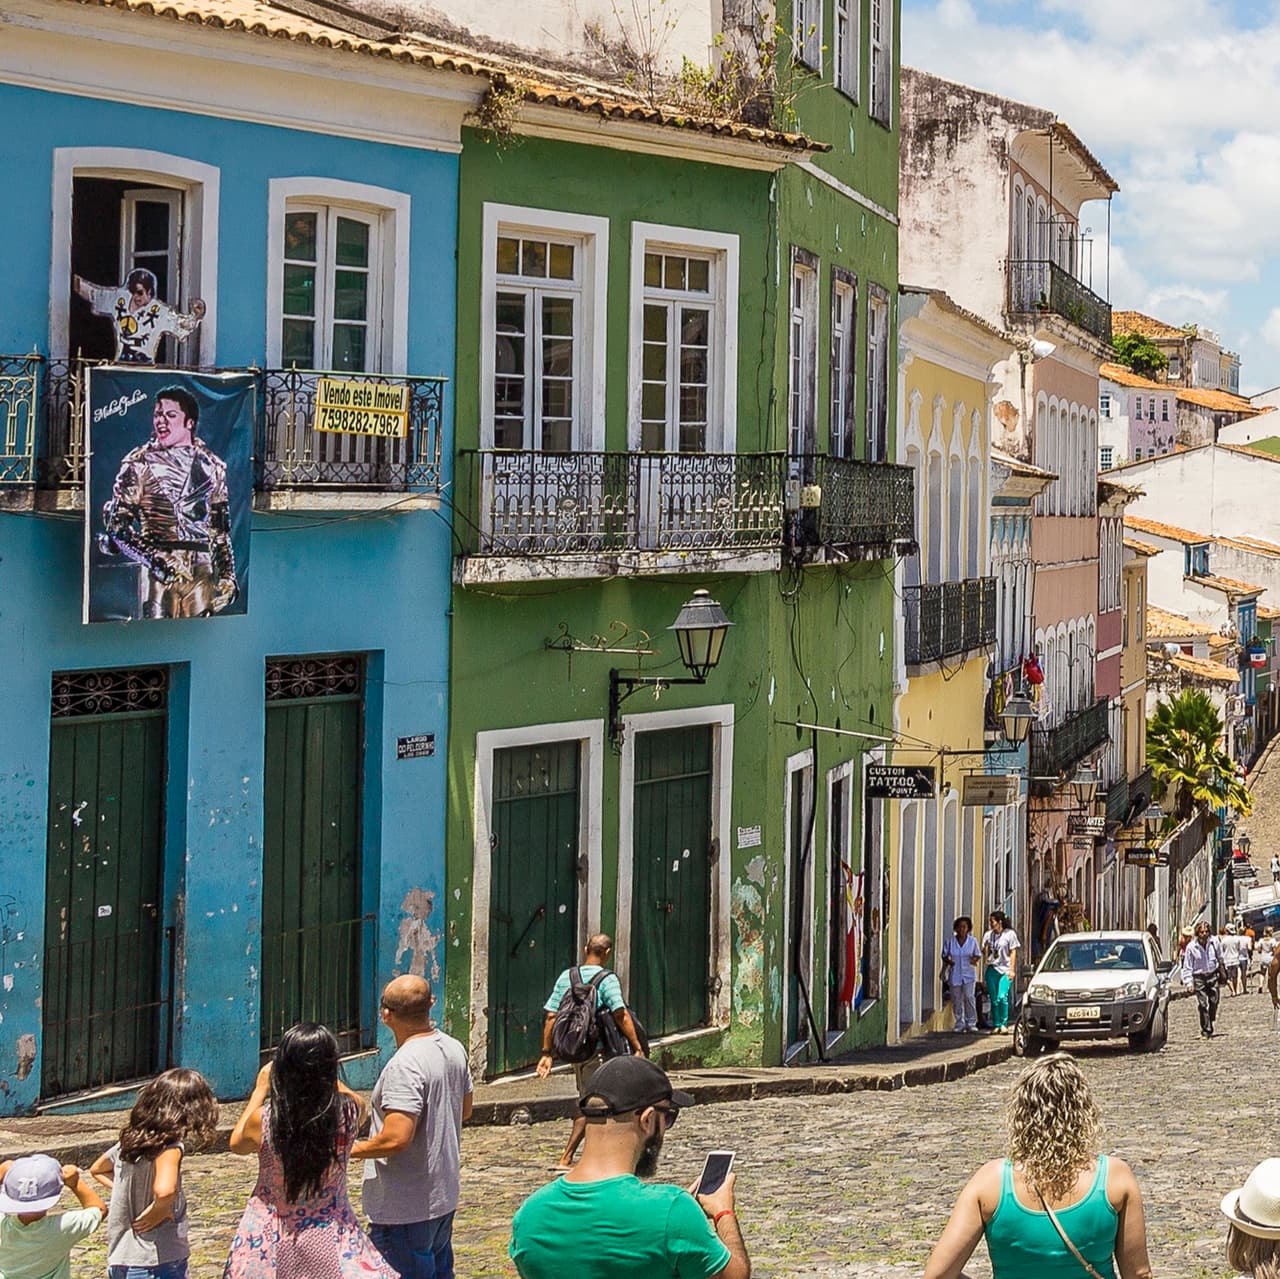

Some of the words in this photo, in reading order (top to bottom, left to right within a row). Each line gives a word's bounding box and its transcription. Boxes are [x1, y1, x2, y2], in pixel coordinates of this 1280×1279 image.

[323, 381, 350, 405] Vendo
[353, 386, 372, 406] este
[374, 386, 403, 410] Imóvel
[321, 408, 399, 435] 7598282-7962
[869, 767, 905, 776] CUSTOM
[869, 776, 915, 787] TATTOO
